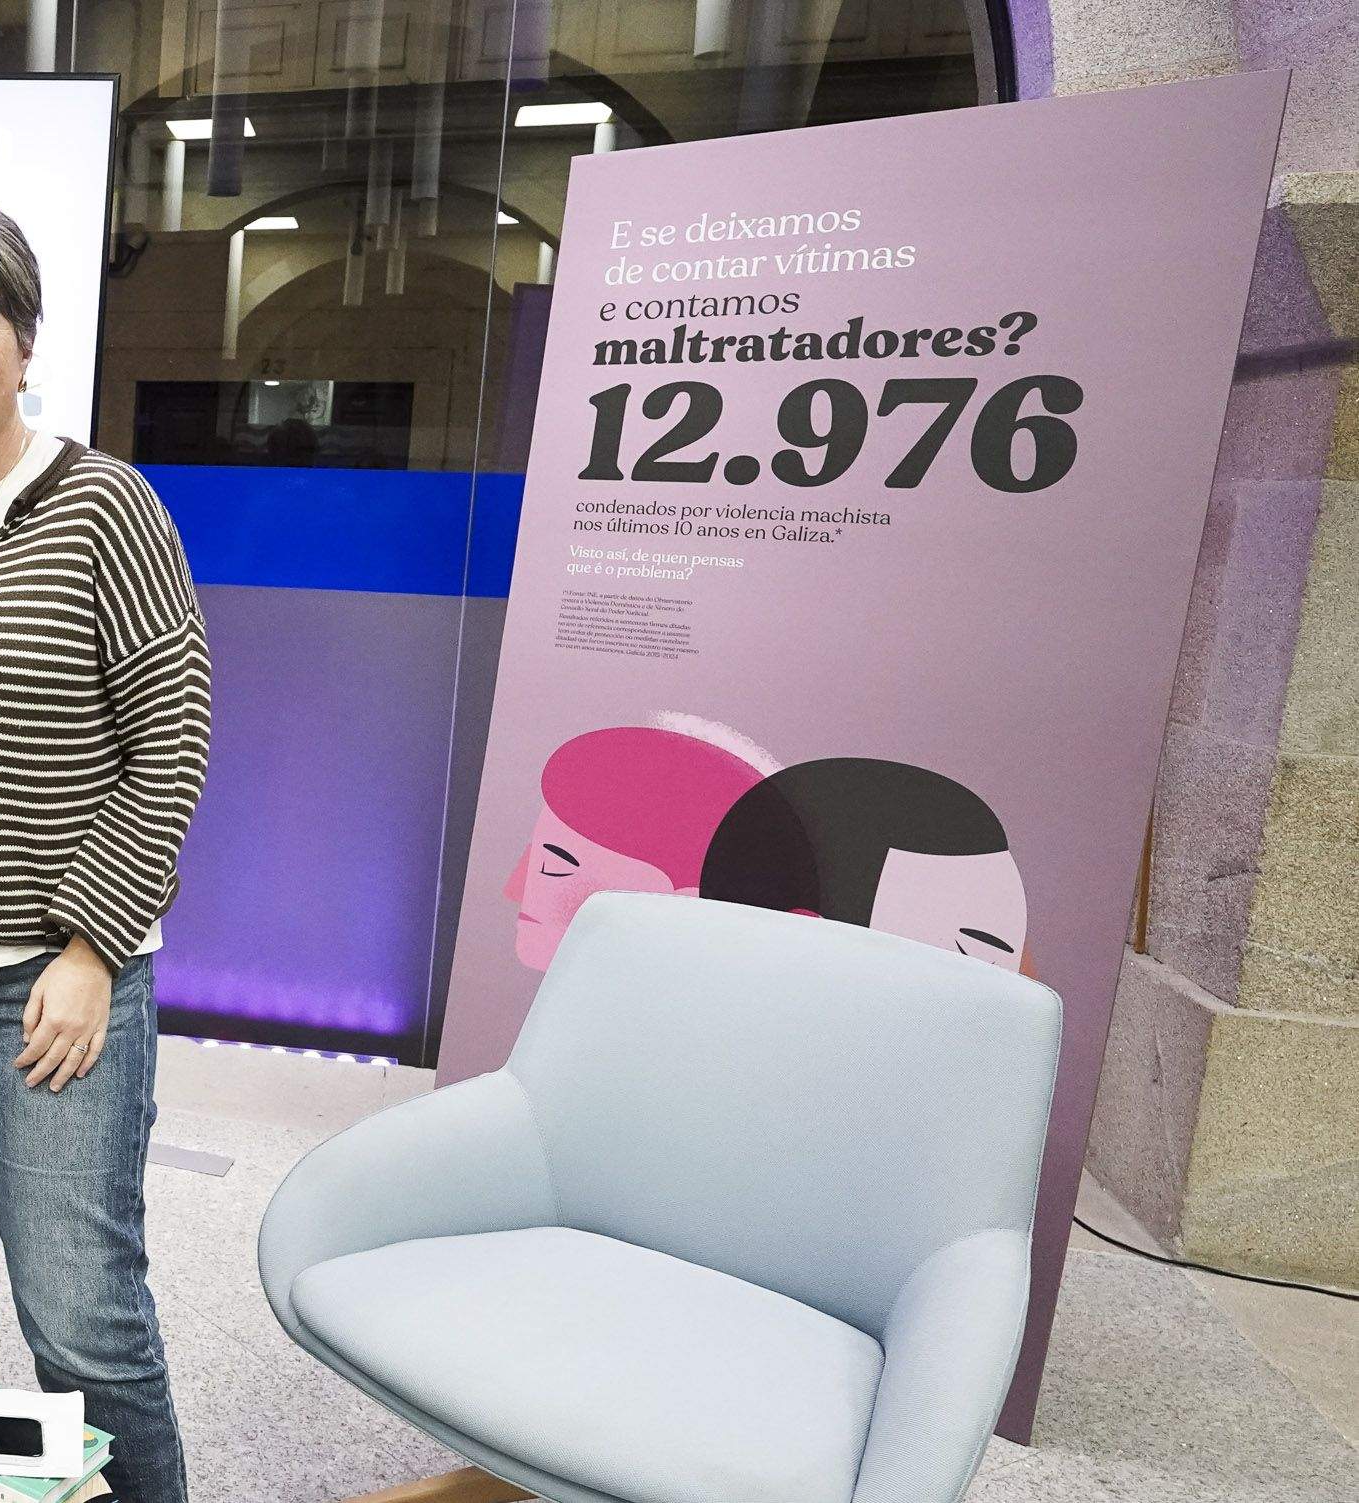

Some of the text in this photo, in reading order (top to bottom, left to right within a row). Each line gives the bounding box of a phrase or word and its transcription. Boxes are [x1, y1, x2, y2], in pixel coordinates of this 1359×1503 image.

[610, 208, 862, 249] E se deixamos
[604, 243, 916, 286] de contar vítimas
[599, 291, 800, 321] e contamos
[592, 311, 1038, 366] maltratadores?
[577, 374, 1084, 494] 12.976
[575, 499, 892, 526] condenados por violencia machista
[573, 518, 603, 532] nos
[606, 517, 669, 536] últimos
[673, 520, 693, 536] 10
[696, 525, 740, 540] anos
[744, 528, 767, 541] en
[566, 562, 694, 581] que é o problema?
[569, 544, 745, 570] Visto así, de quen pensas
